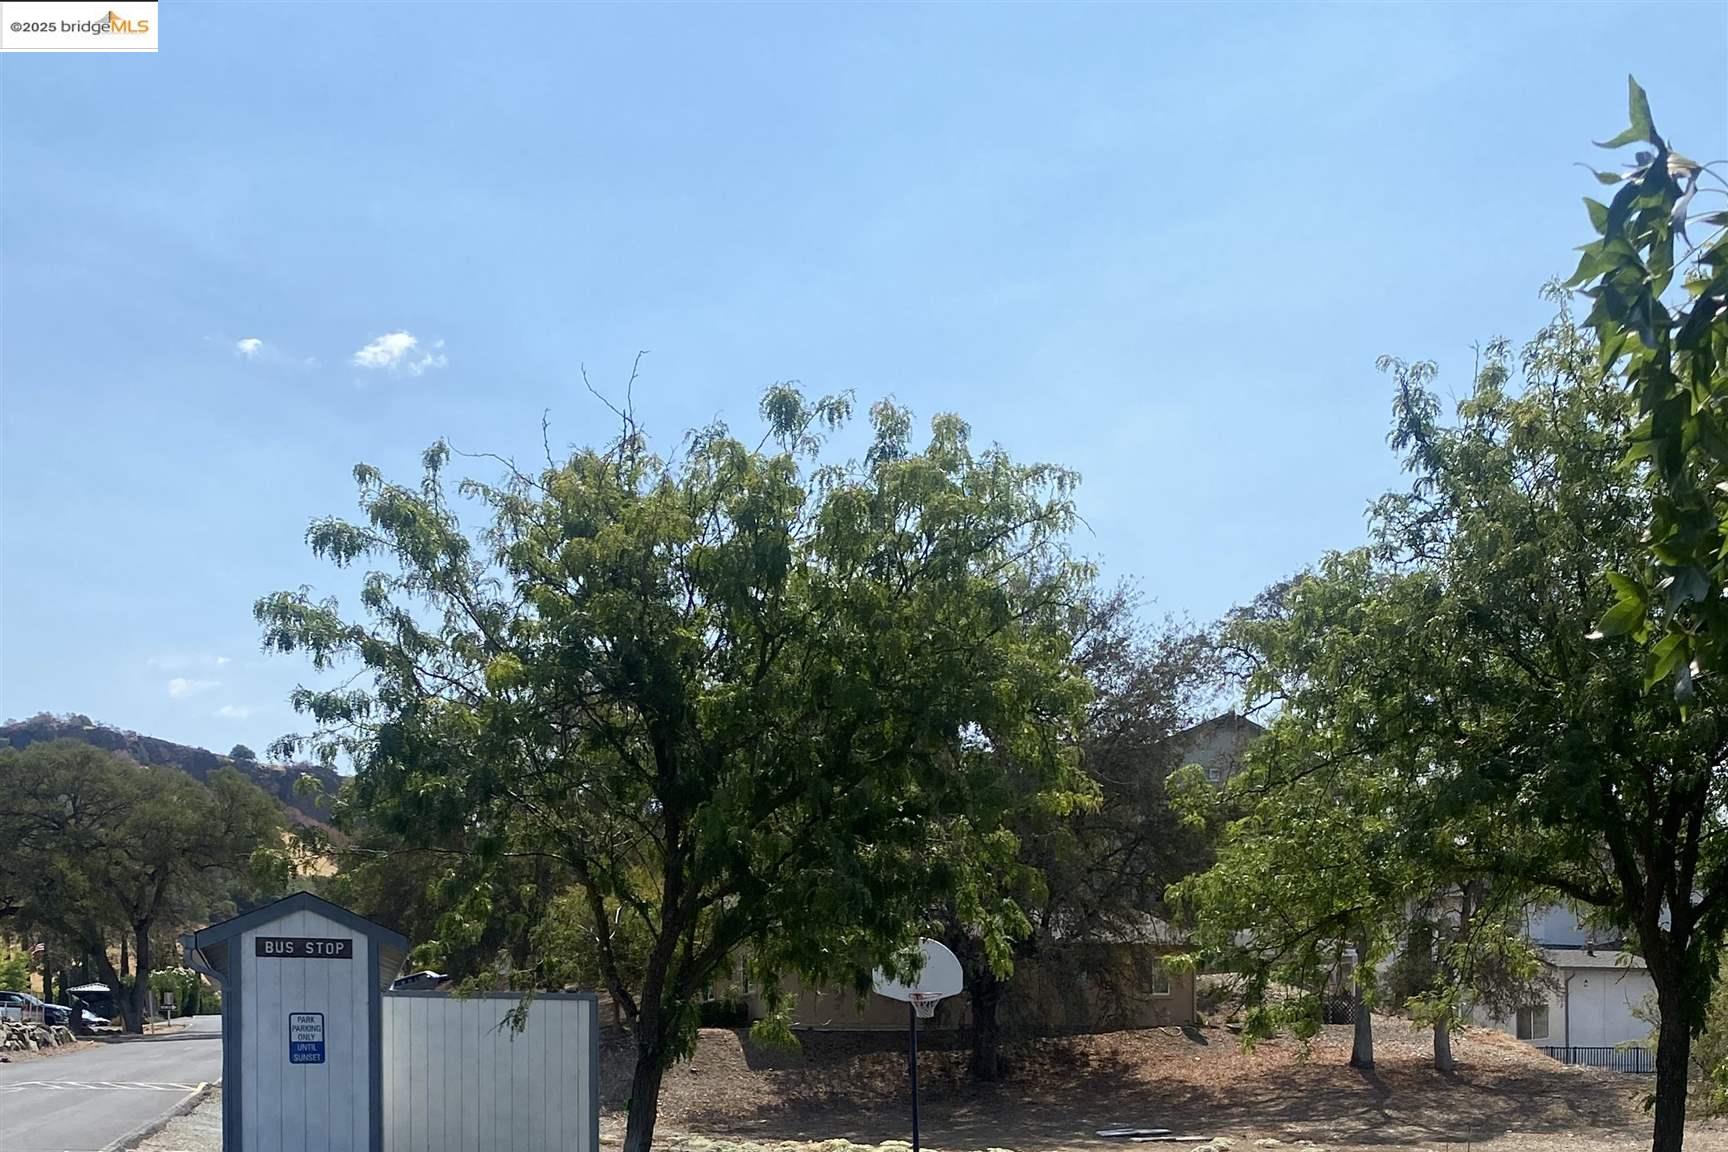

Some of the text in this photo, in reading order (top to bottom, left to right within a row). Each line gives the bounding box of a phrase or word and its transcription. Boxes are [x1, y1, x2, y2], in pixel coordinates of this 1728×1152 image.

[264, 940, 344, 955] BUS STOP
[297, 1015, 316, 1023] PARK
[292, 1024, 322, 1033] PARKING
[297, 1033, 316, 1041] ONLY
[297, 1043, 318, 1051] UNTIL
[293, 1053, 321, 1062] SUNSET
